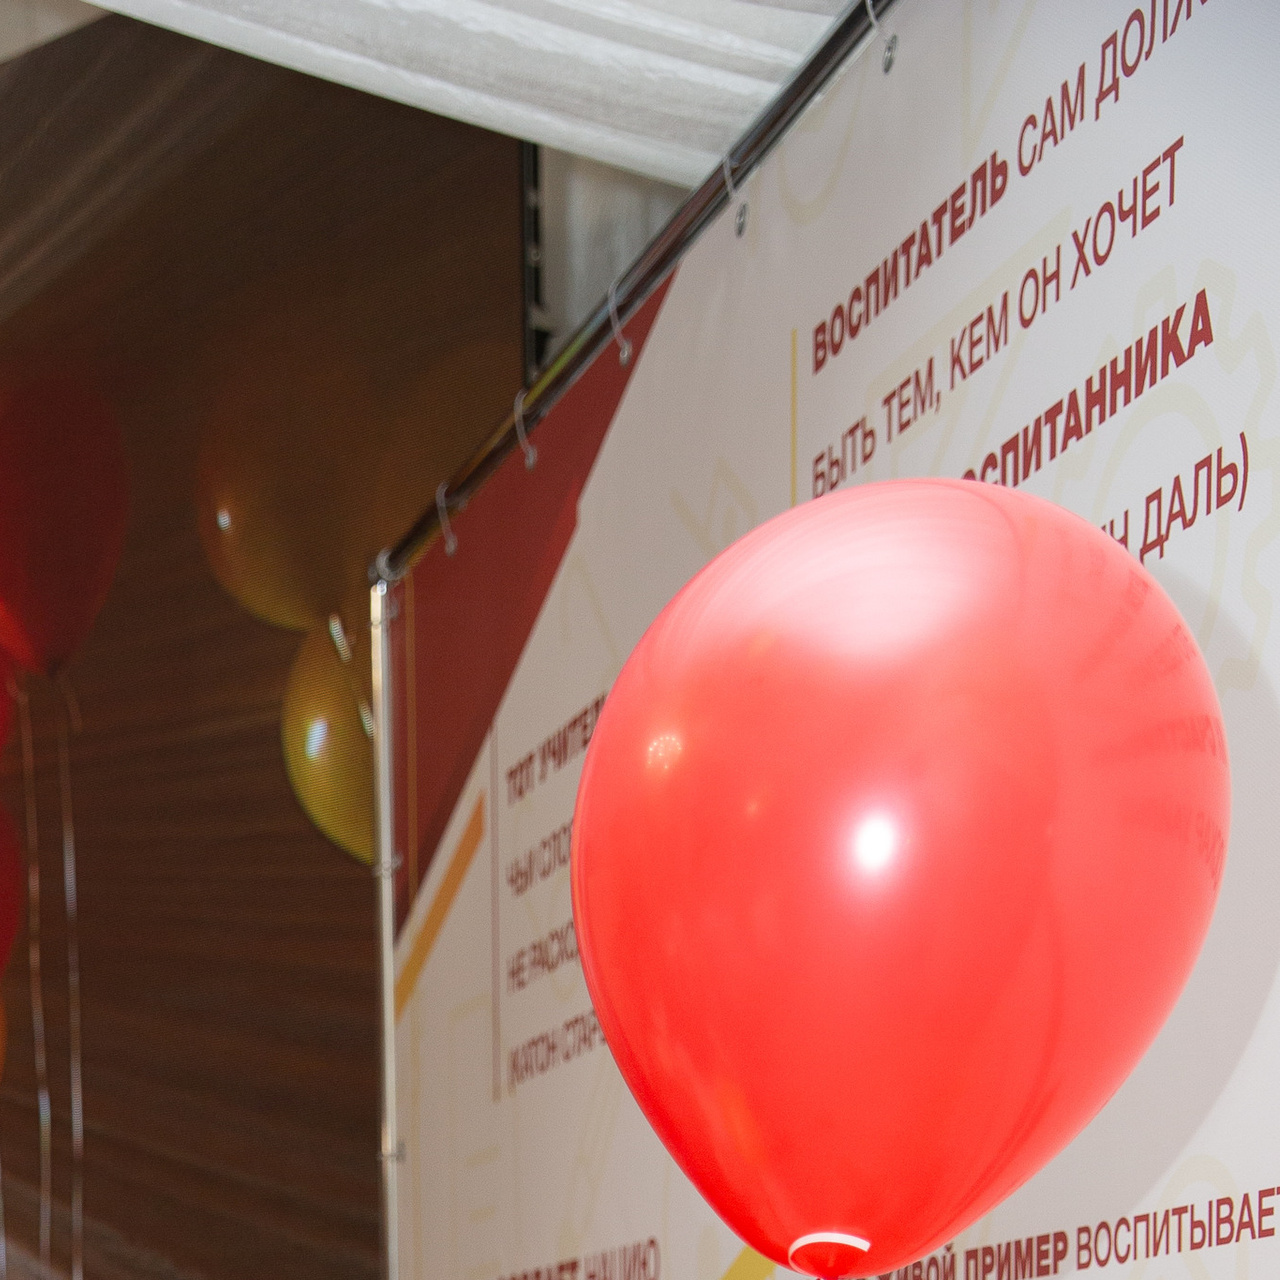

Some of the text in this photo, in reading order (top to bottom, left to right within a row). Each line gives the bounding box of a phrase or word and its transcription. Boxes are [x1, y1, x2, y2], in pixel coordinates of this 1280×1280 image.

[813, 0, 1208, 376] ВОСПИТАТЕЛЬ САМ ДОЛ
[812, 135, 1184, 499] БЫТЬ ТЕМ, КЕМ ОН ХОЧЕТ
[1139, 432, 1248, 565] ДАЛЬ)
[1077, 1186, 1280, 1271] ВОСПИТЫВАЕ
